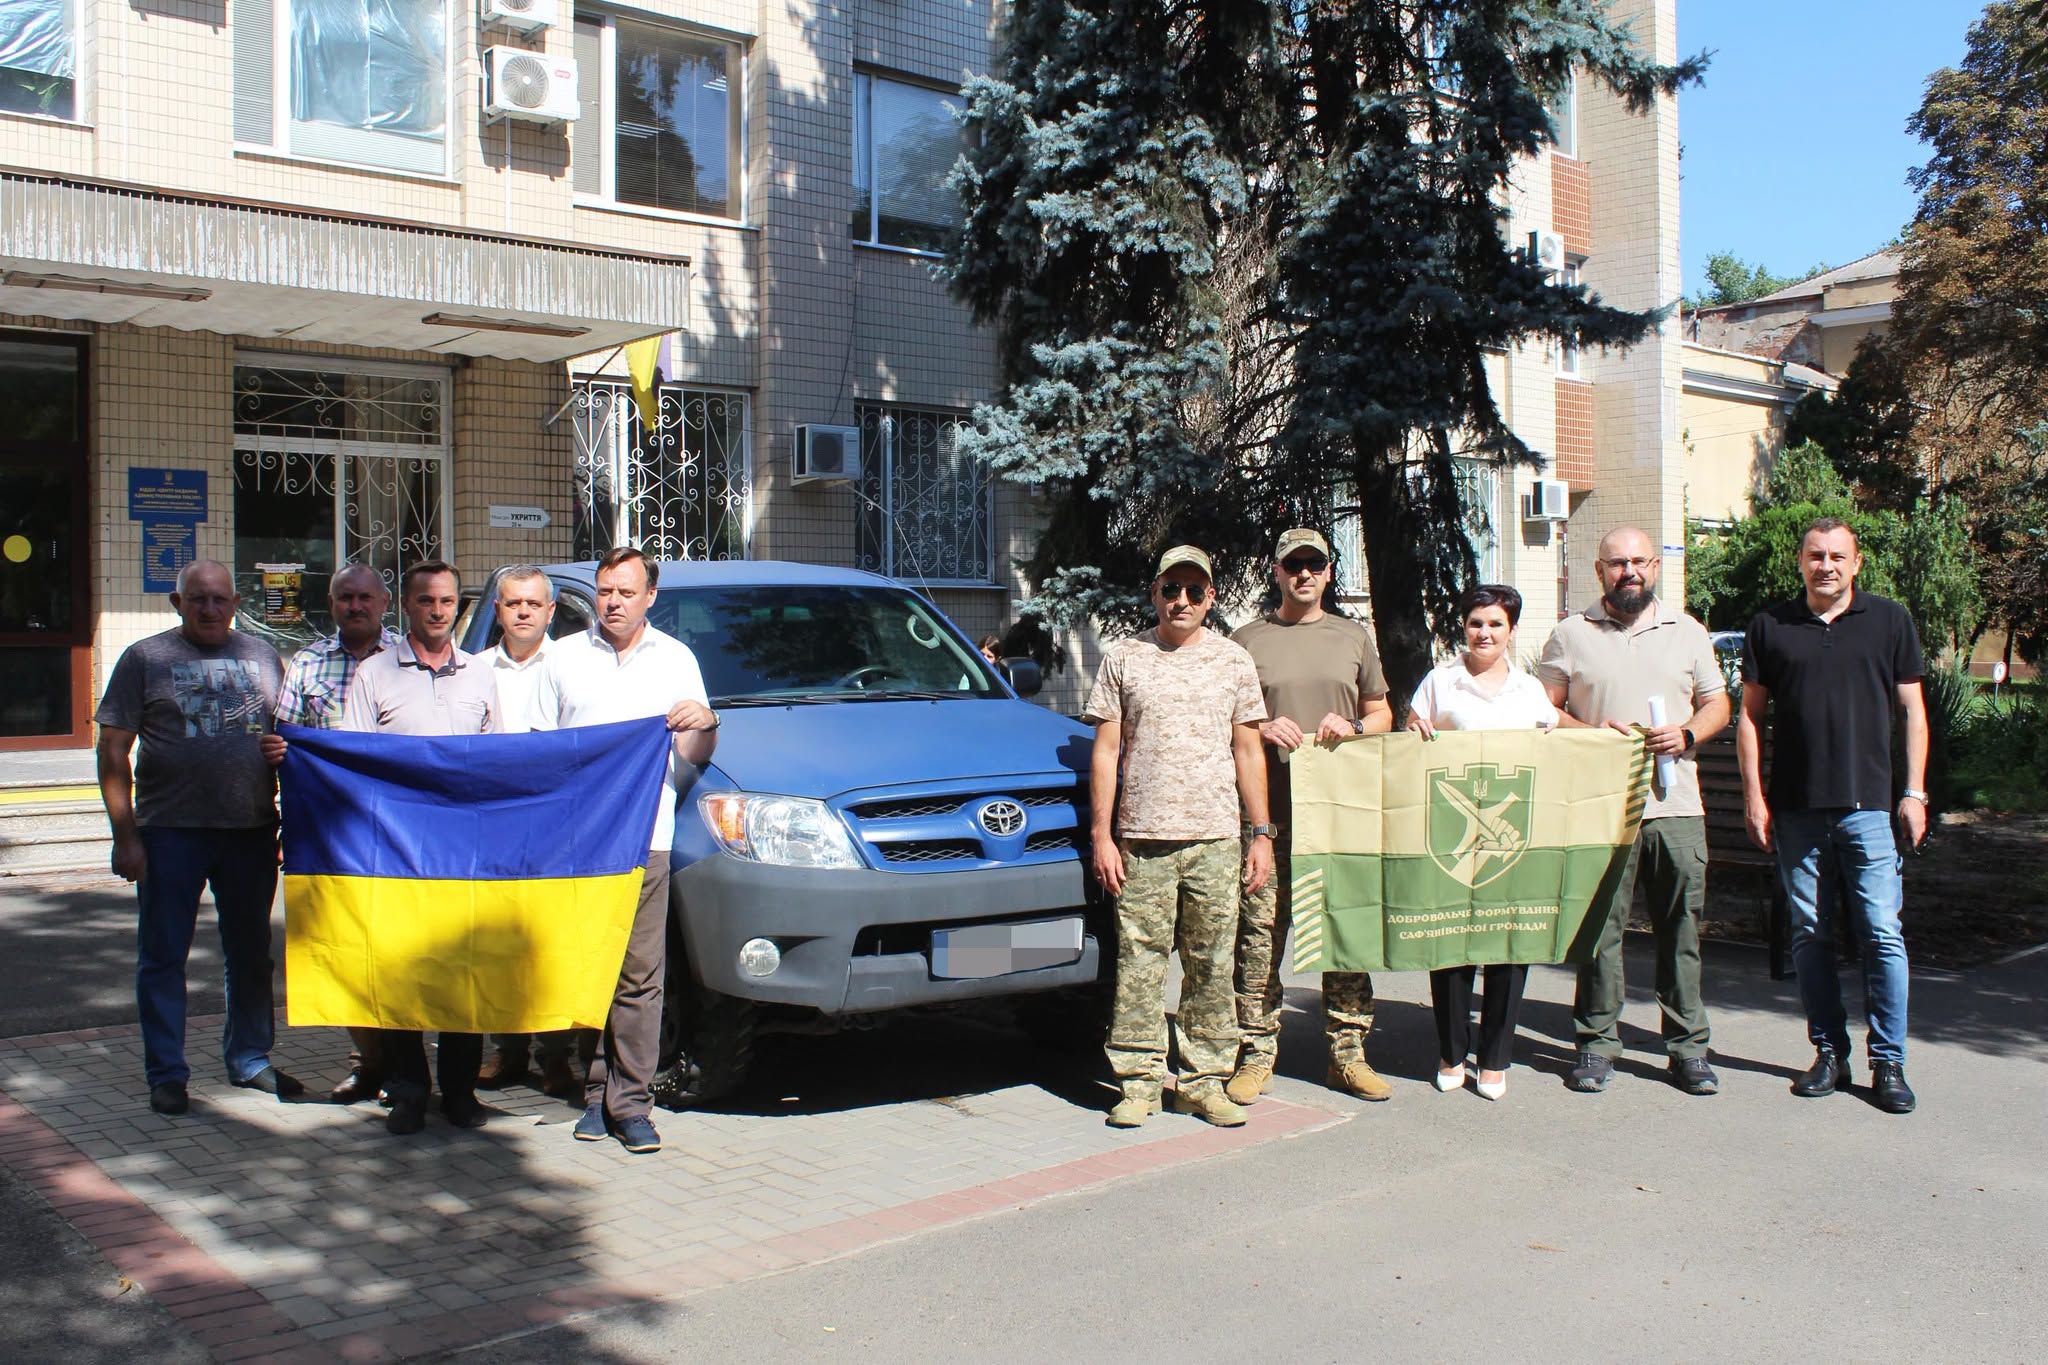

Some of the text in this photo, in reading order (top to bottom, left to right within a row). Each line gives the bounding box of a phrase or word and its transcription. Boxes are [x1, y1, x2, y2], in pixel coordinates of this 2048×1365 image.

[511, 513, 542, 521] УКРИТТЯ
[1387, 906, 1559, 924] ДОБРОВОЛЬЧЕ ФОРМУВАННЯ
[1489, 921, 1547, 931] ГРОМАДИ
